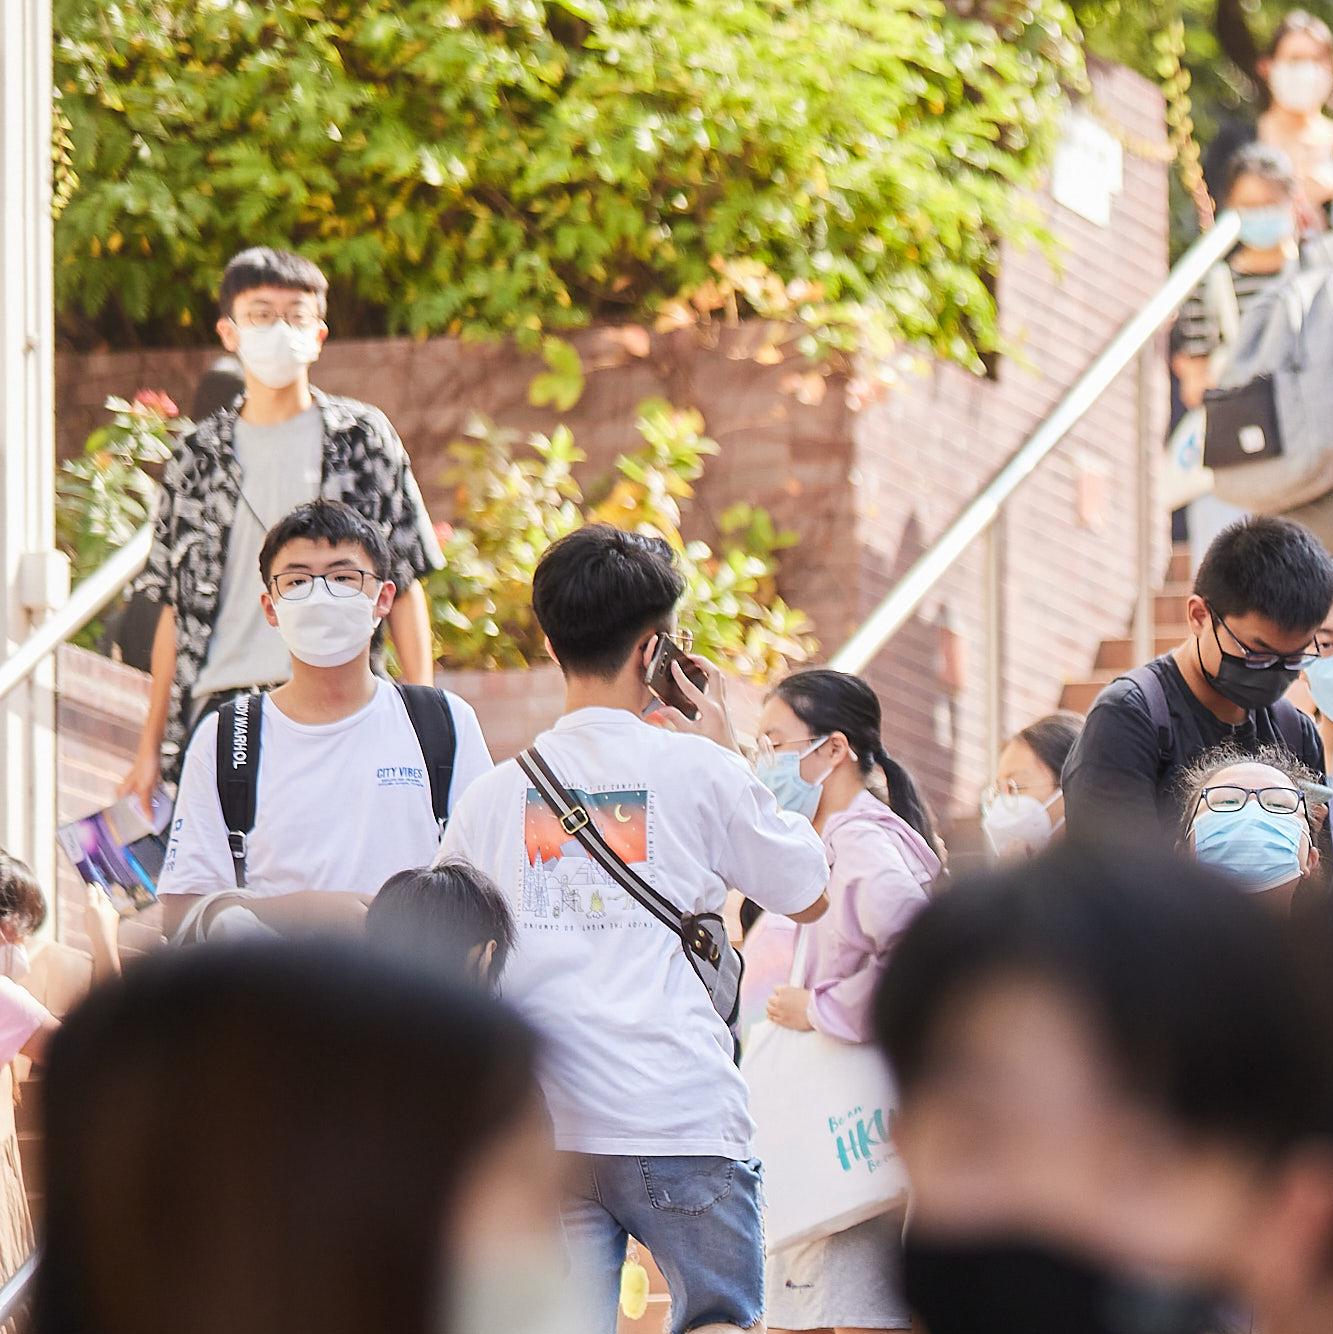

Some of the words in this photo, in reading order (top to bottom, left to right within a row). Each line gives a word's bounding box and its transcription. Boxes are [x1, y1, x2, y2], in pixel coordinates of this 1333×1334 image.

[232, 716, 249, 770] WARHOL
[377, 767, 397, 779] CITY
[399, 766, 423, 779] VIBES
